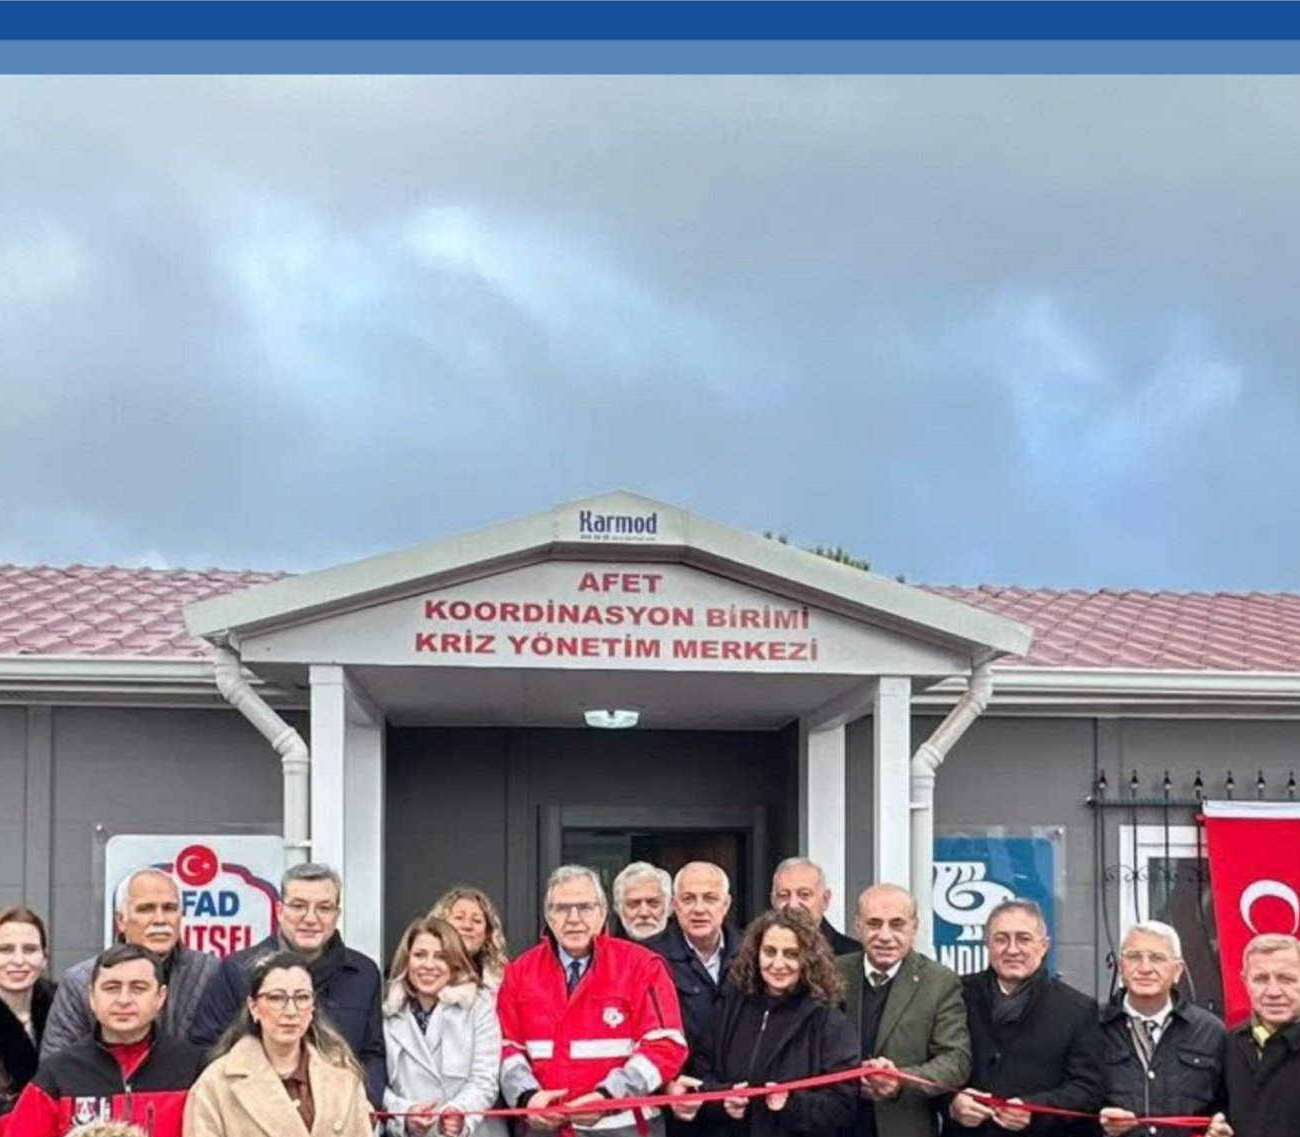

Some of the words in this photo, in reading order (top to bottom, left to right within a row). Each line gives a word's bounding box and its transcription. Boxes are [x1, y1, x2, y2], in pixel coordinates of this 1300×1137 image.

[579, 509, 658, 534] Karmod
[577, 572, 664, 594] AFET
[424, 599, 695, 628] KOORDİNASYON
[706, 603, 810, 630] BİRİMİ
[414, 629, 496, 655] KRİZ
[507, 632, 662, 659] YÖNETİM
[672, 637, 819, 662] MERKEZİ
